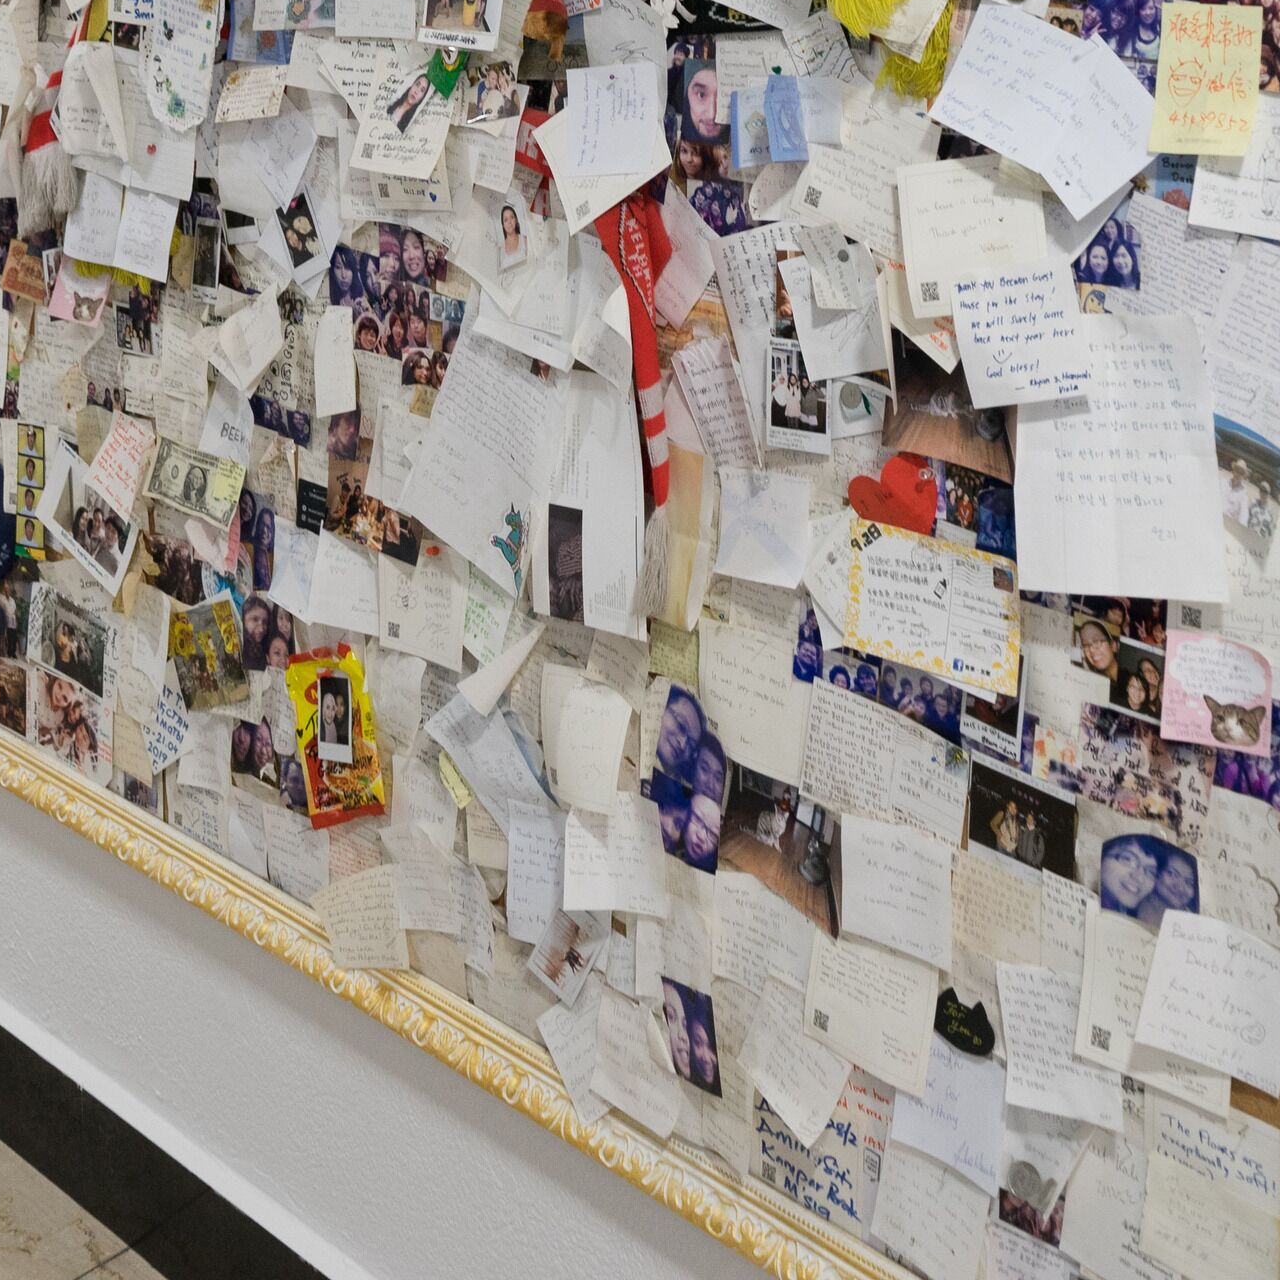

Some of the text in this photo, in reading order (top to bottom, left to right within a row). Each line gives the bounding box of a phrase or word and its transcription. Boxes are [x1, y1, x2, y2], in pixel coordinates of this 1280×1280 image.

[850, 523, 883, 552] 9.28
[147, 741, 169, 765] 2019
[1159, 1112, 1191, 1138] The
